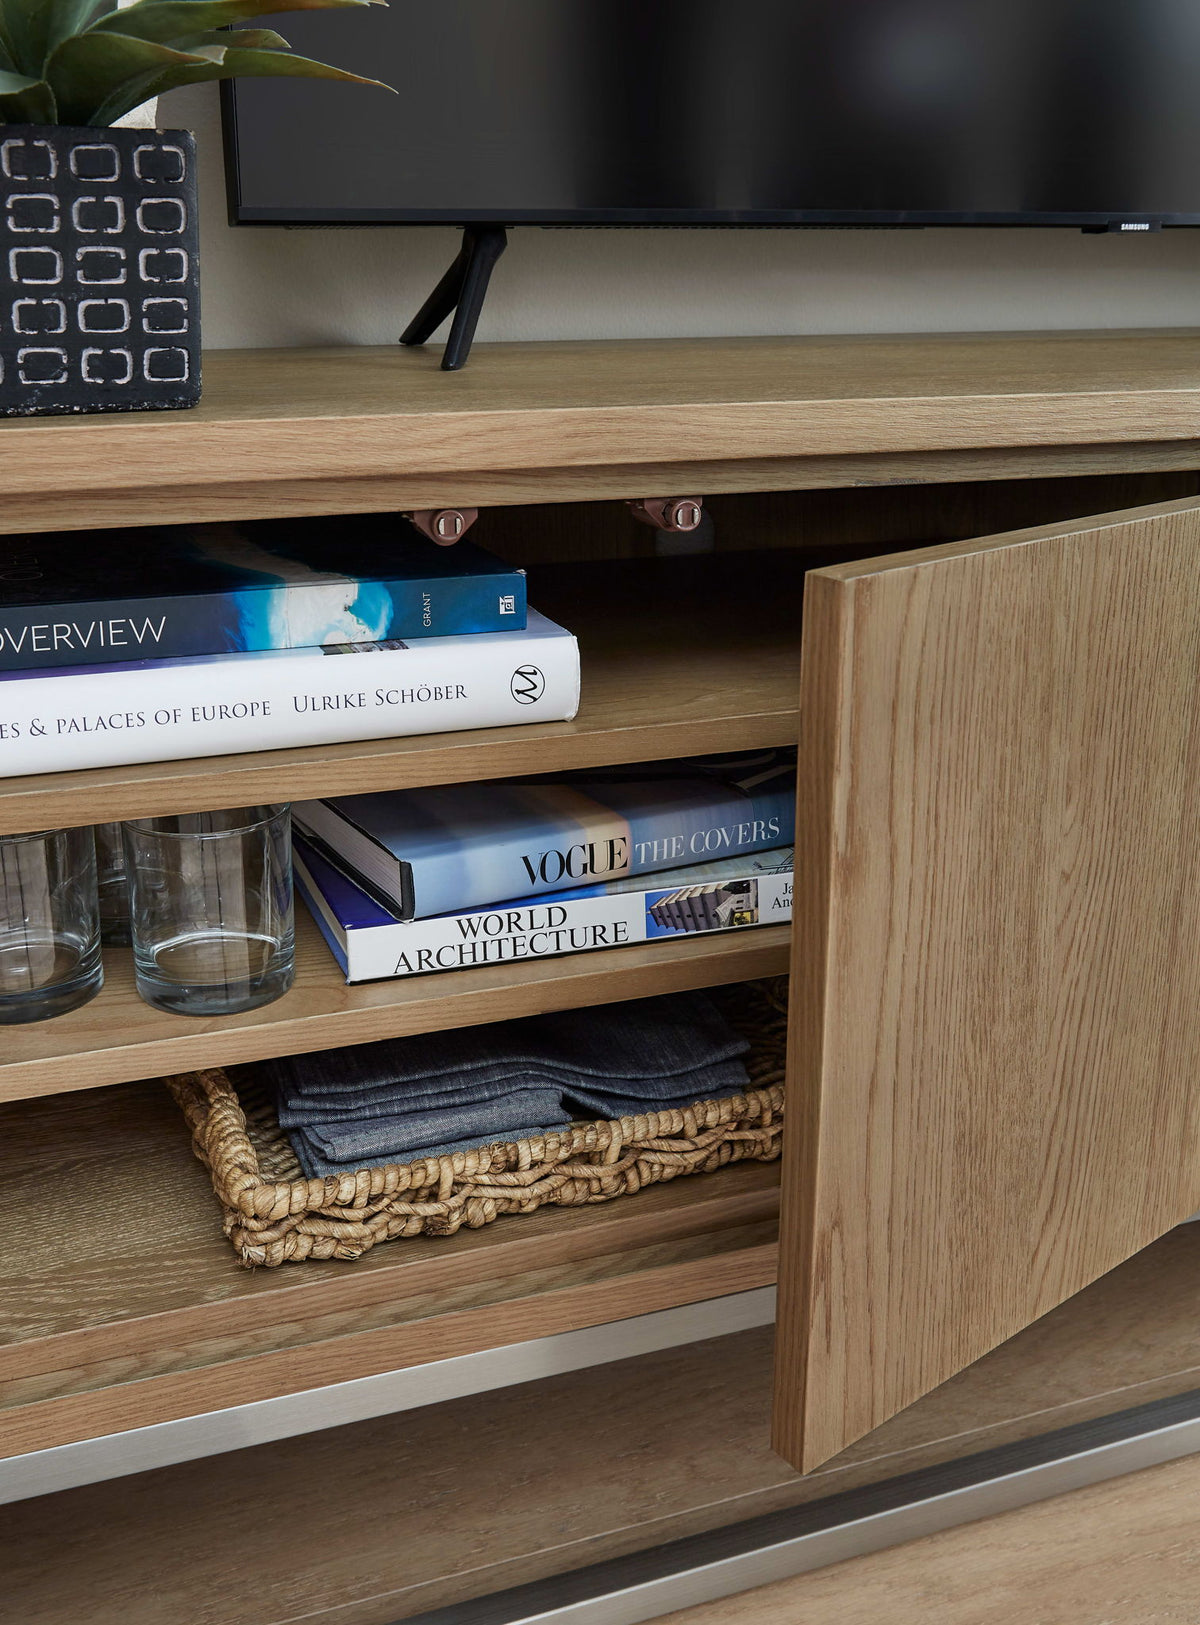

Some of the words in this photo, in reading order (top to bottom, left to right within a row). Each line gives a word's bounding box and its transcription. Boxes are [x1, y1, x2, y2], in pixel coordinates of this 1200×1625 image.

[423, 592, 431, 627] GRANT
[0, 616, 166, 654] VERVIEW
[293, 692, 366, 712] ULRIKE
[375, 682, 467, 706] SCHÖBER
[29, 718, 48, 737] &
[56, 711, 146, 734] PALACES
[154, 708, 182, 726] OF
[191, 700, 271, 722] EUROPE
[520, 837, 628, 886] VOGUE
[635, 835, 684, 864] THE
[689, 817, 781, 854] COVERS
[456, 905, 568, 939] WORLD
[393, 921, 629, 974] ARCHITECTURE
